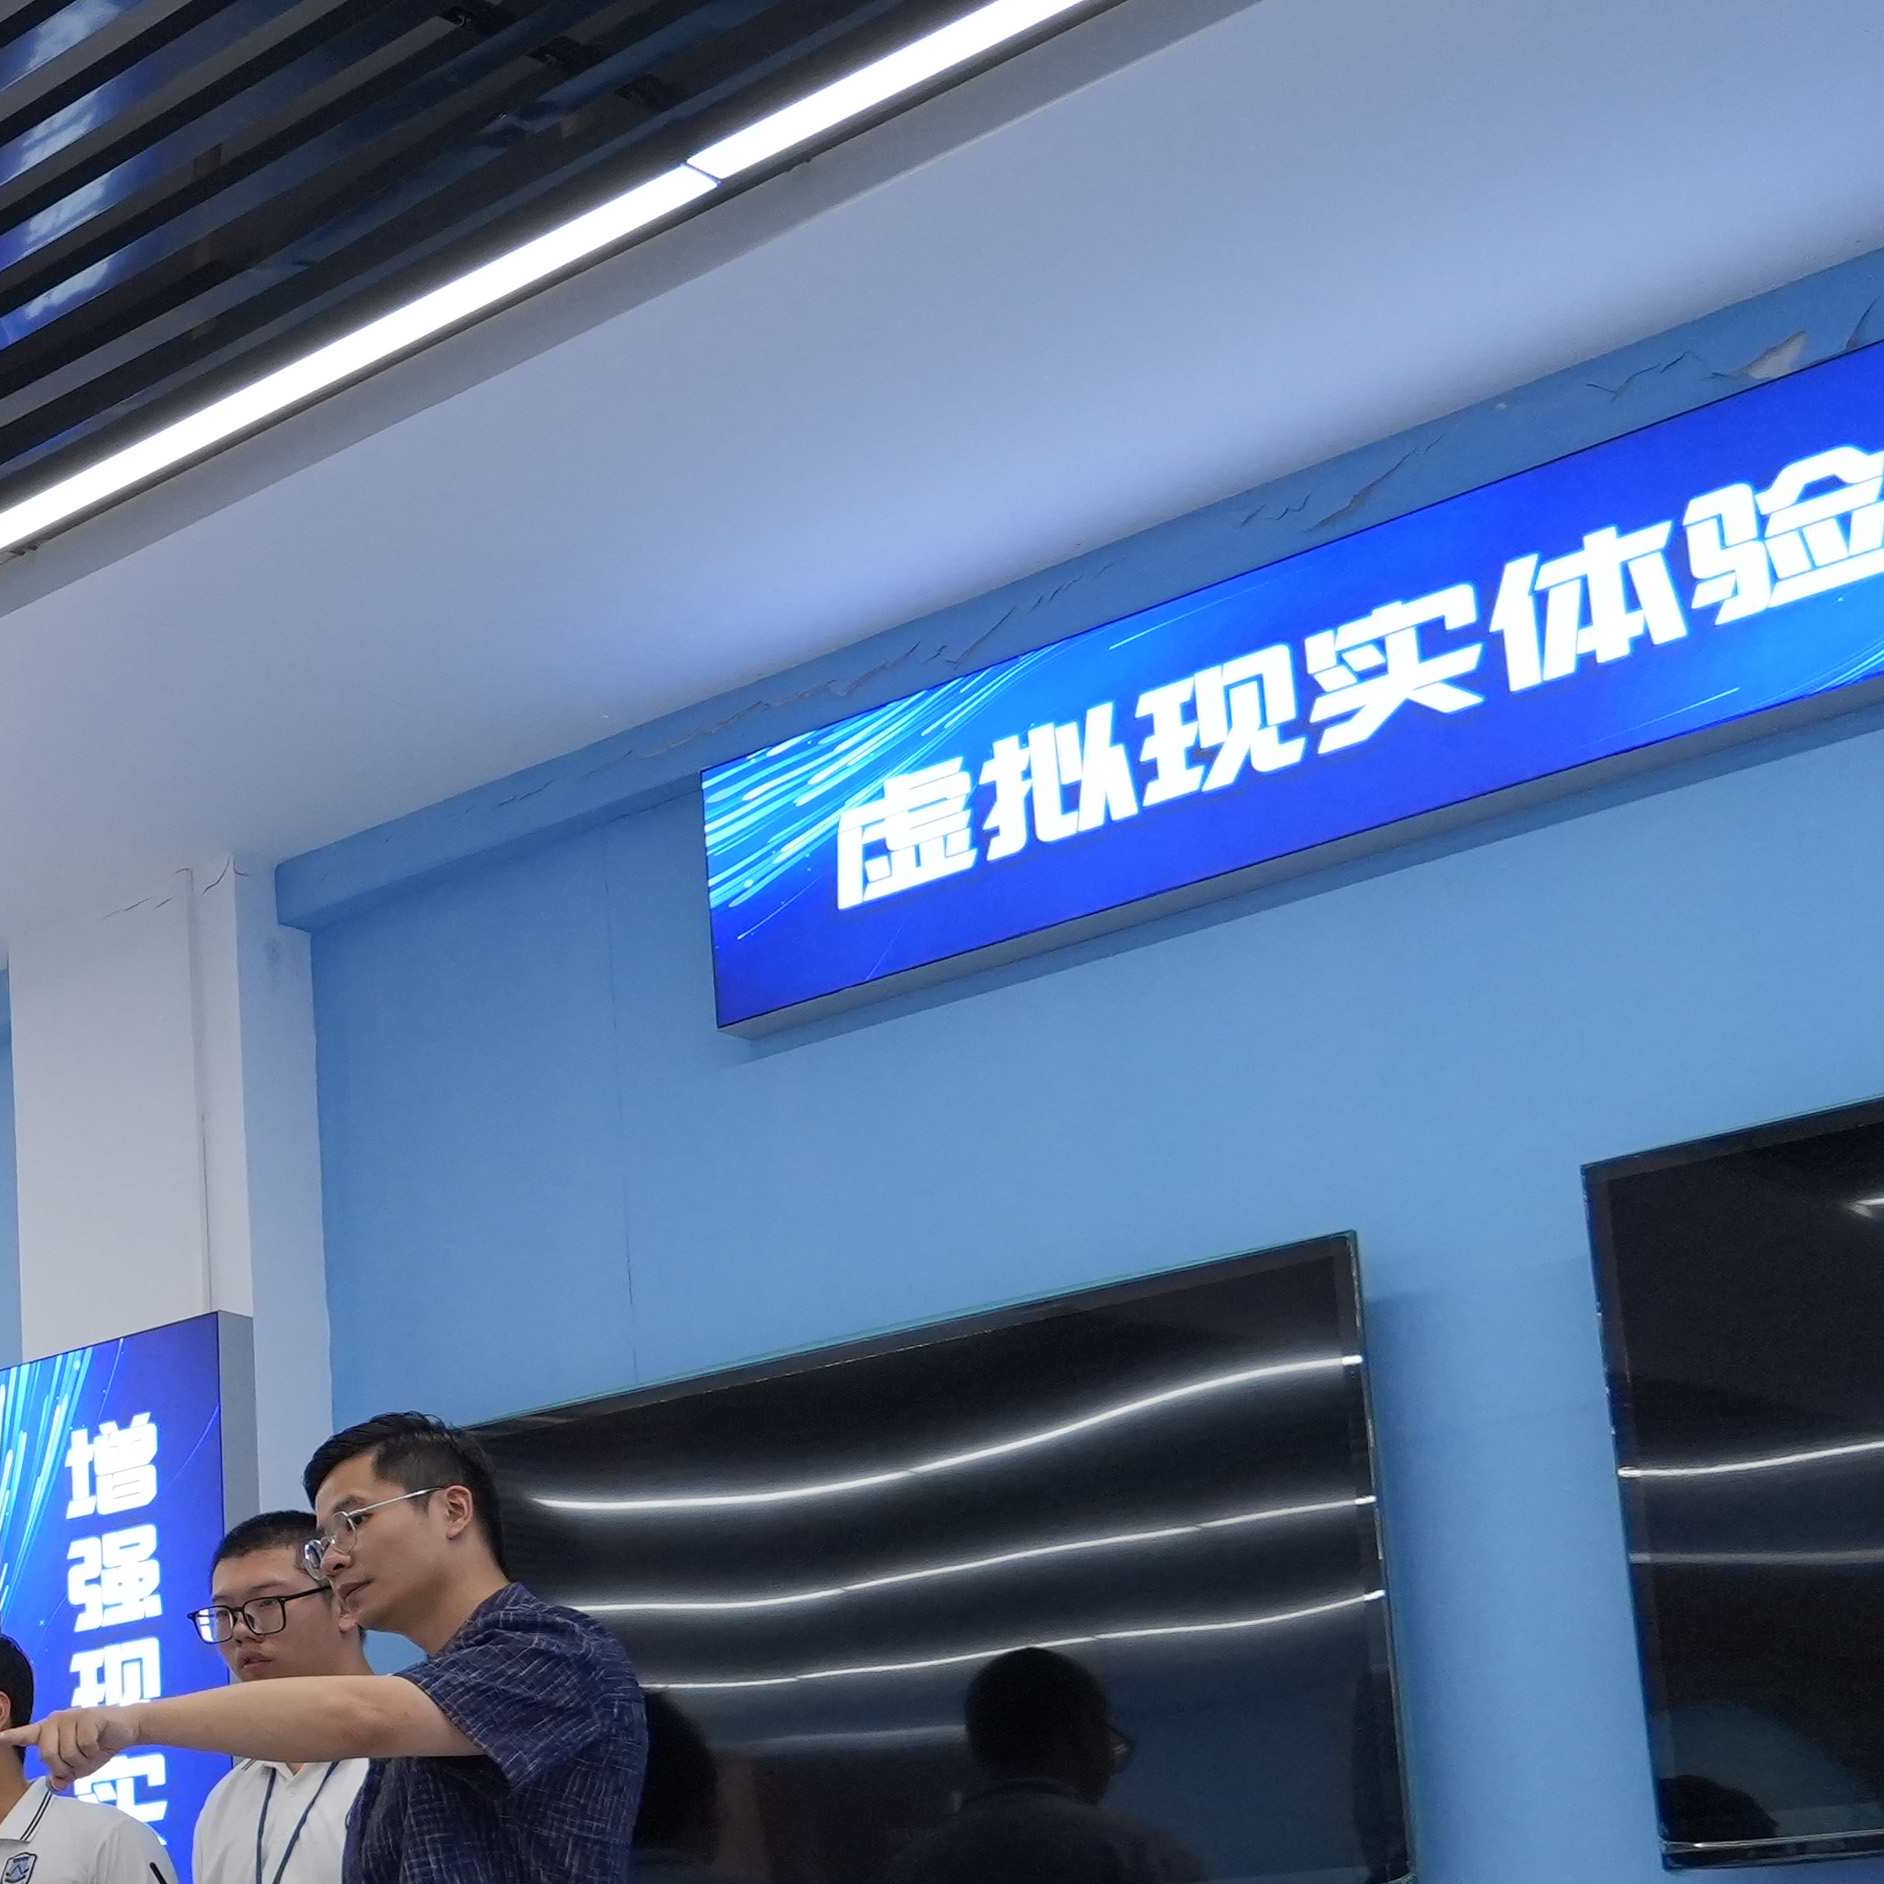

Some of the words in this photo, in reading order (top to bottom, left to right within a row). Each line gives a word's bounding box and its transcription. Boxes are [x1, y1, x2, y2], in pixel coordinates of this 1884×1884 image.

[836, 446, 1884, 909] 虚拟现实体验
